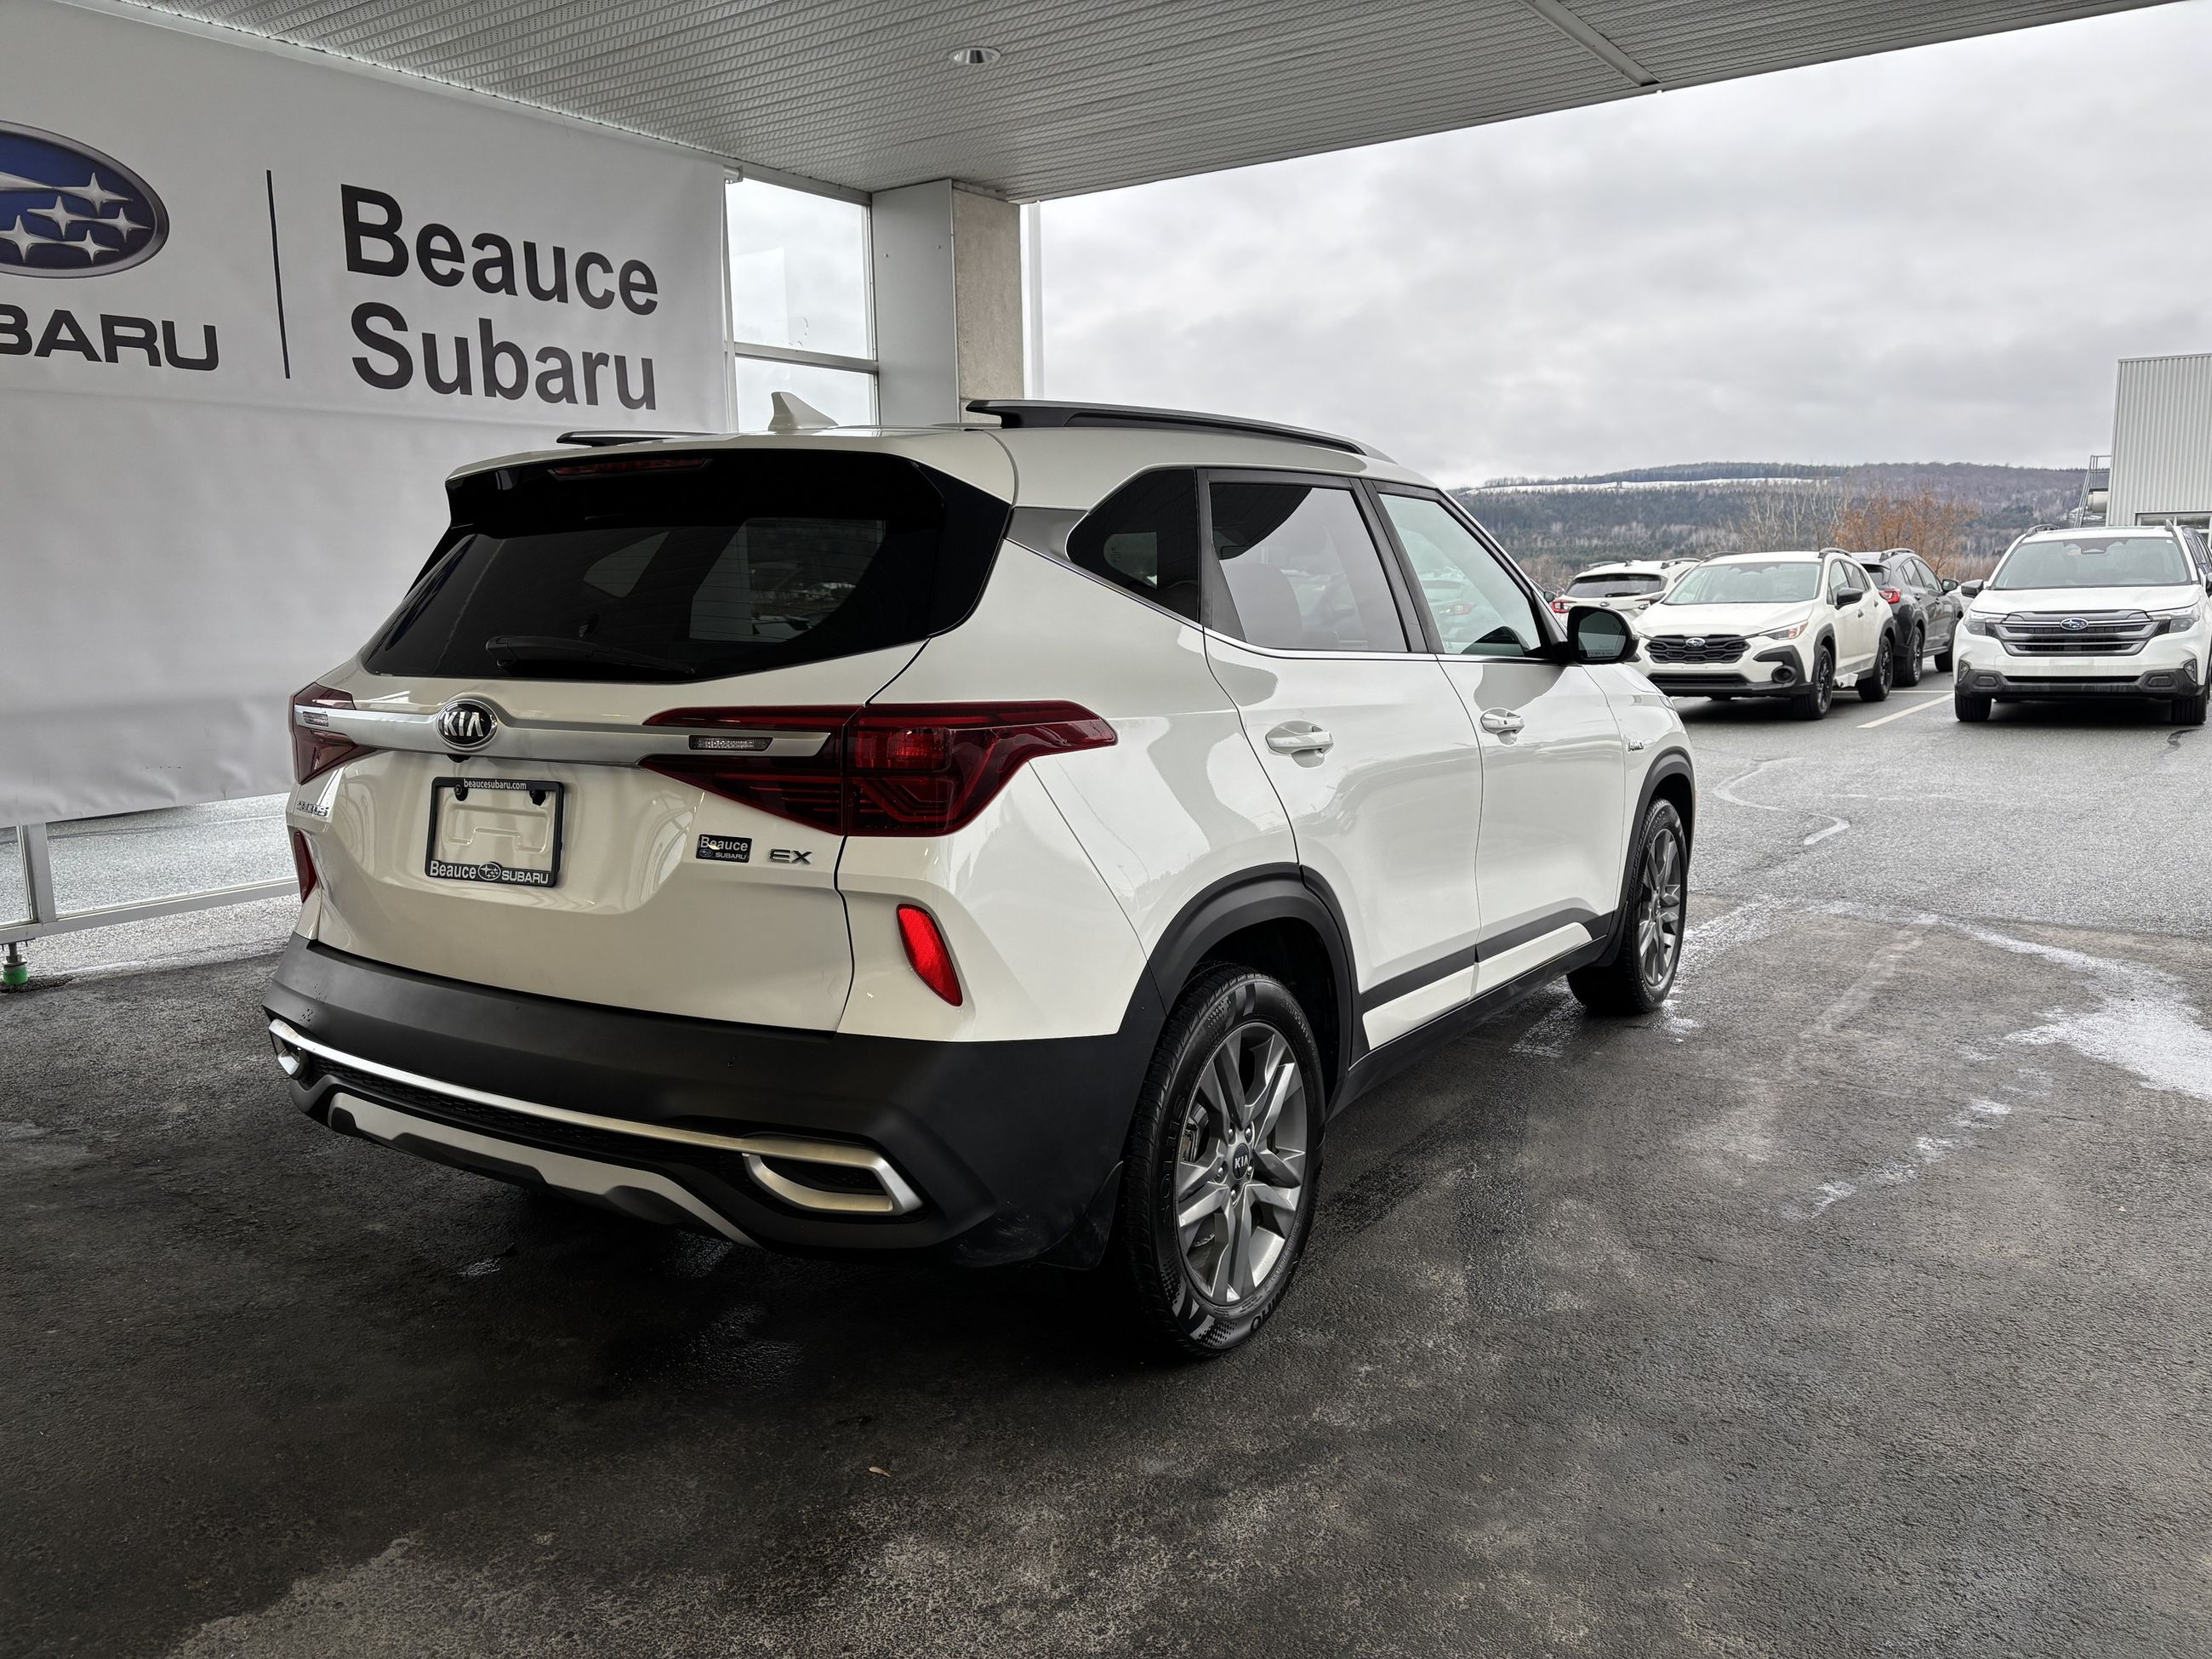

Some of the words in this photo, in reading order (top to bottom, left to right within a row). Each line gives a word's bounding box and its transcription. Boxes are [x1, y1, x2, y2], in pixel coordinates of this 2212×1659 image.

[340, 184, 658, 316] Beauce
[351, 302, 657, 410] Subaru
[443, 711, 484, 737] KIA
[464, 778, 527, 790] beaucesubaru.com
[700, 836, 749, 851] Beauce
[715, 852, 746, 860] SUBARU
[769, 848, 812, 865] EX
[430, 860, 476, 879] Beauce
[501, 870, 549, 884] SUBARU
[1234, 1154, 1248, 1169] KIA
